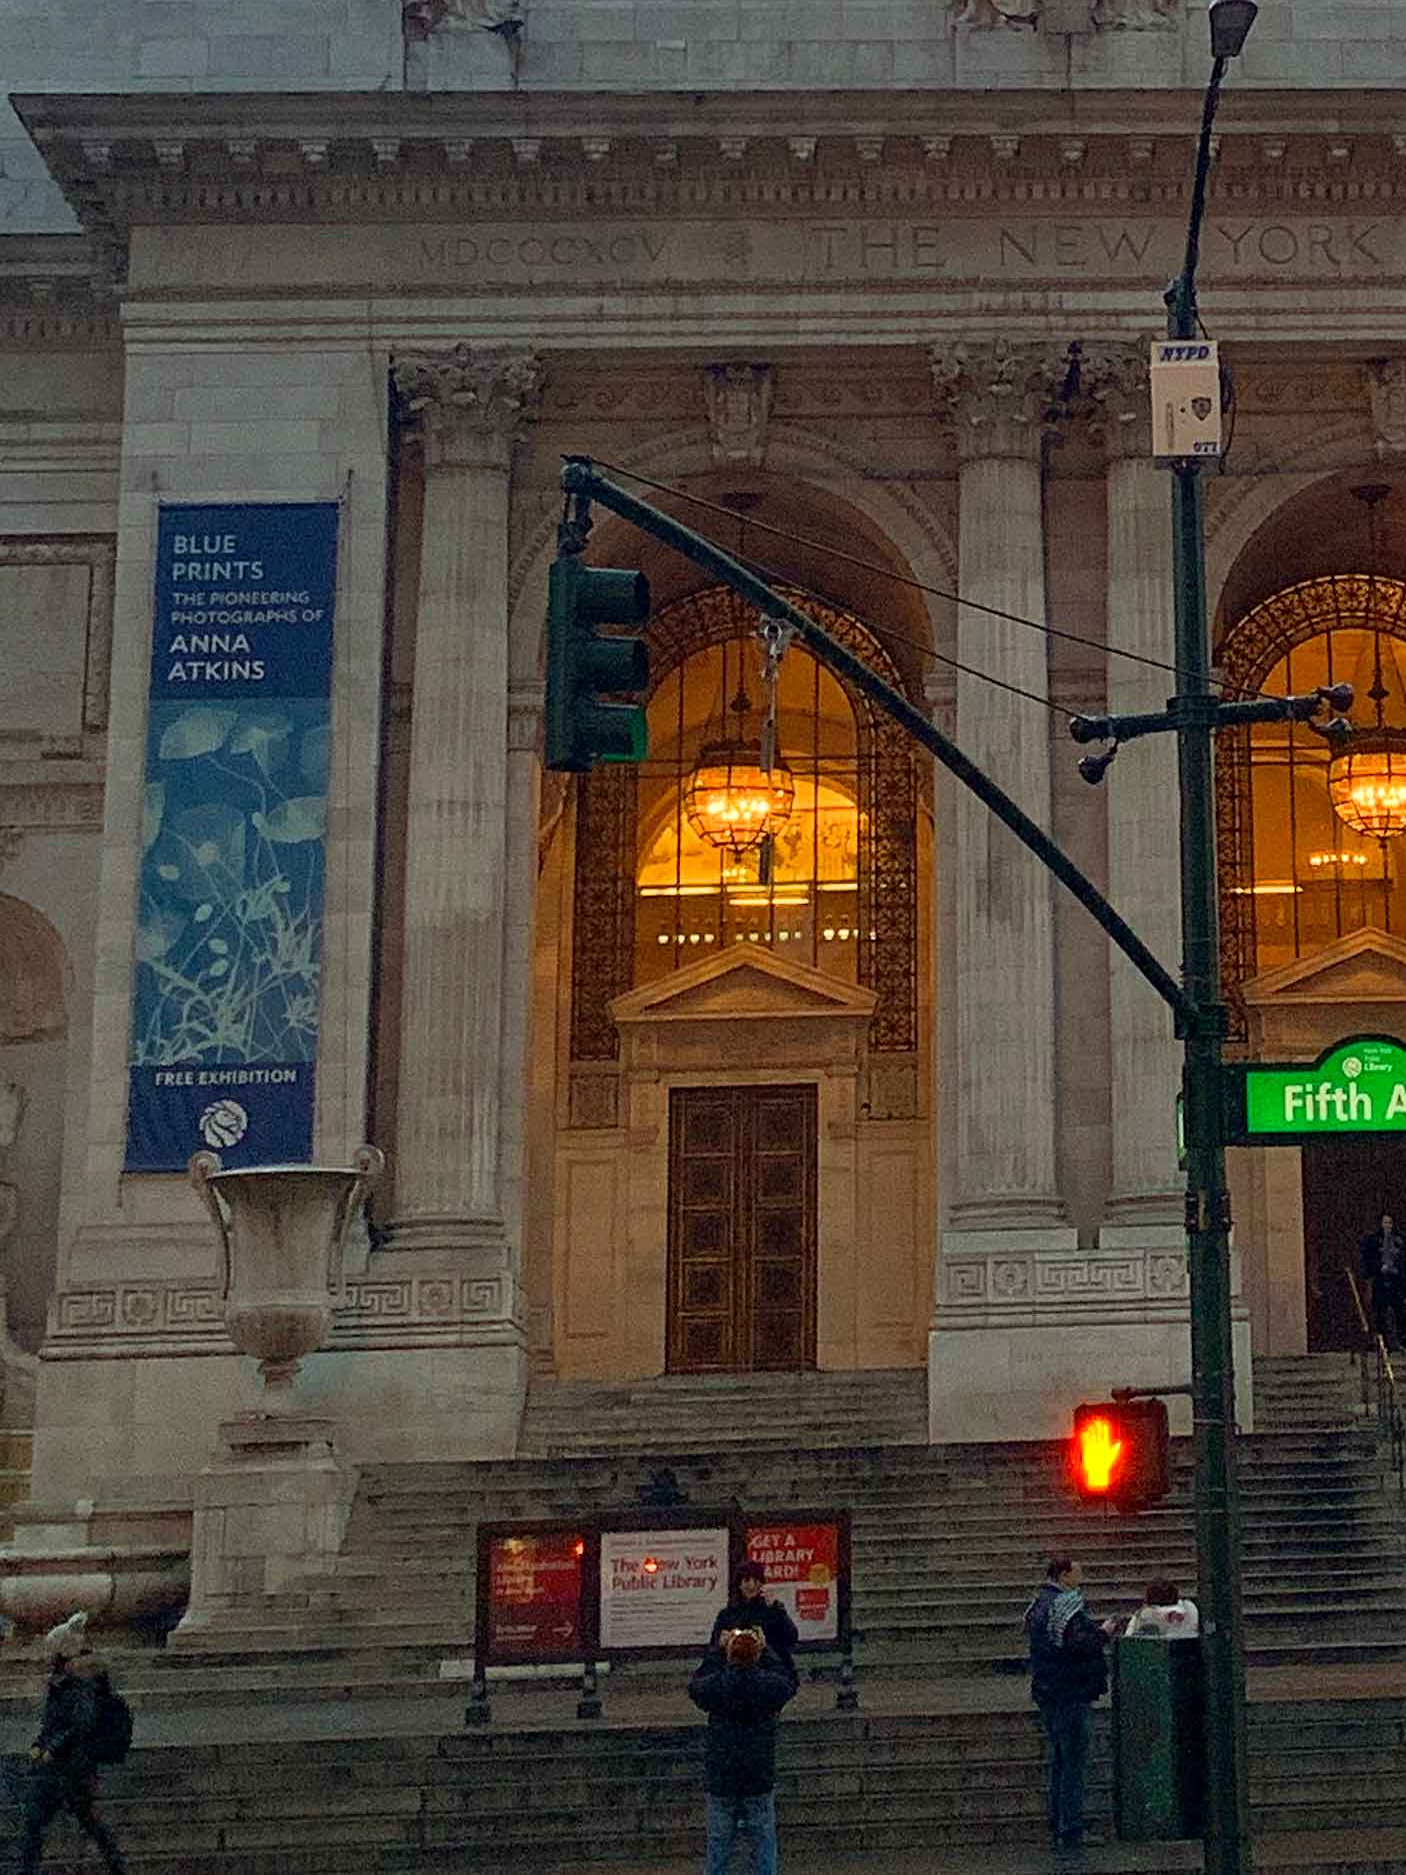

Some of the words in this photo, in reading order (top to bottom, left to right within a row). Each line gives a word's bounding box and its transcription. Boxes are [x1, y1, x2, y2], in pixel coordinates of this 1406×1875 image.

[812, 225, 945, 270] THE
[1000, 224, 1159, 267] NEW
[1218, 224, 1385, 267] YORK
[1161, 346, 1209, 362] NYPD
[173, 534, 236, 554] BLUE
[172, 561, 264, 581] PRINTS
[173, 592, 207, 606] THE
[210, 590, 310, 605] PIONEERING
[171, 609, 297, 625] PHOTOGRAPHS
[302, 609, 324, 622] OF
[169, 634, 250, 653] ANNA
[168, 661, 265, 681] ATKINS
[155, 1070, 194, 1086] FREE
[199, 1069, 297, 1085] EXHIBITION
[1284, 1082, 1372, 1122] Fifth
[752, 1533, 780, 1549] GET
[783, 1533, 796, 1547] A
[610, 1558, 639, 1574] The
[684, 1553, 718, 1571] York
[752, 1548, 815, 1564] LIBRARY
[763, 1565, 800, 1580] ARD!
[611, 1574, 657, 1591] Public
[662, 1573, 718, 1593] Library
